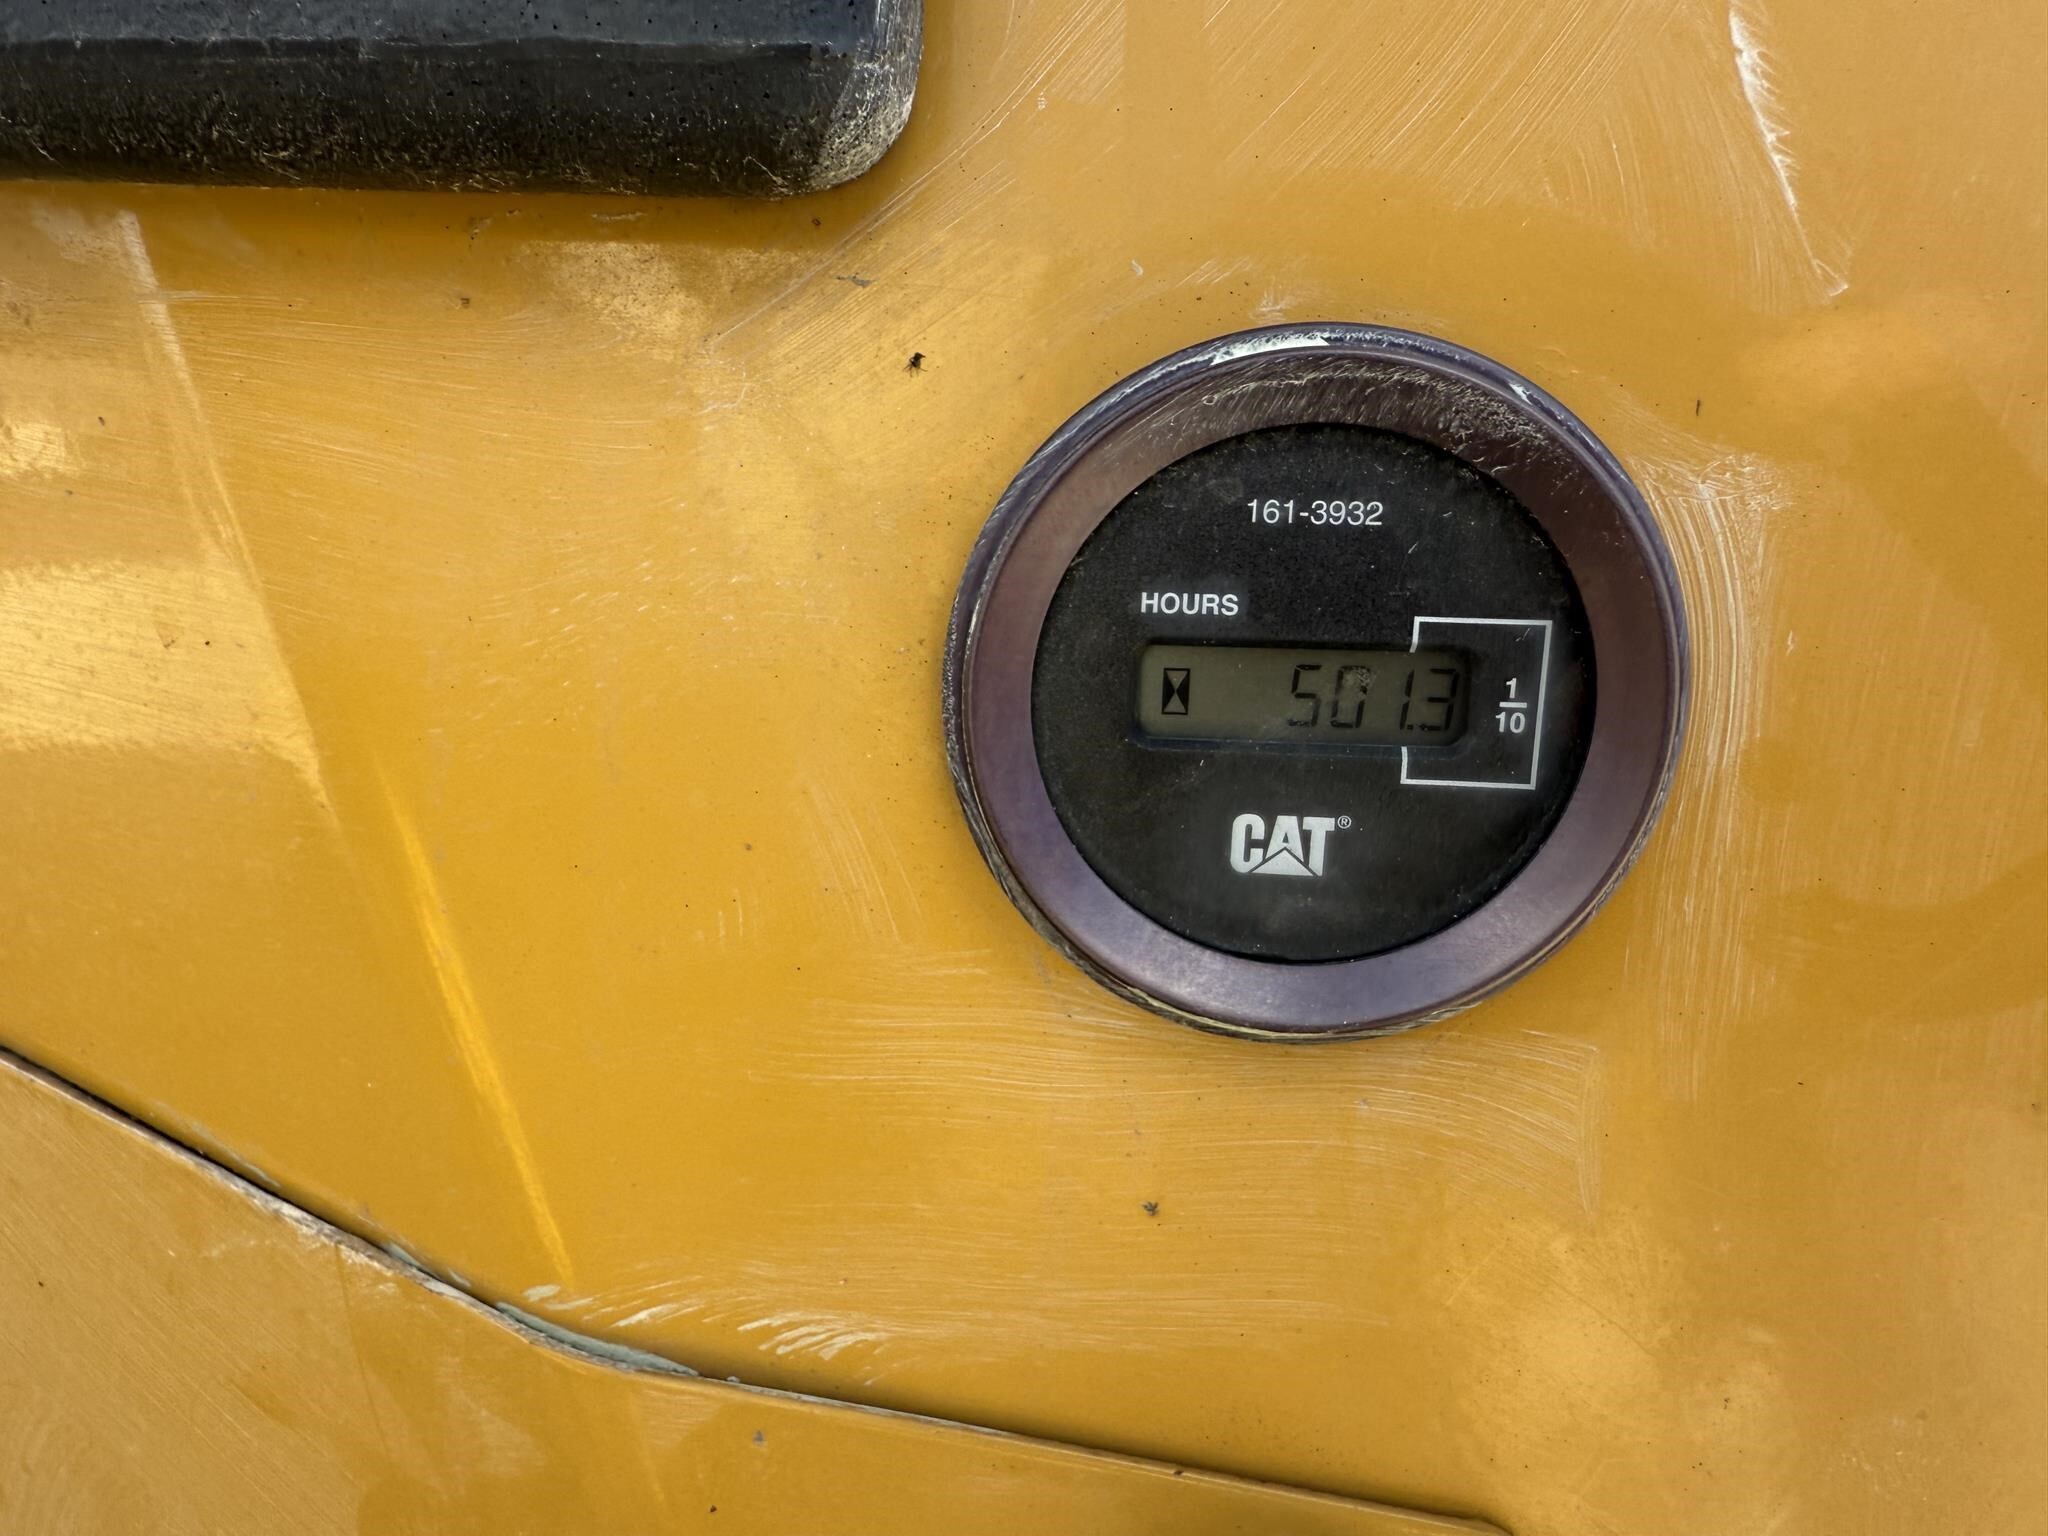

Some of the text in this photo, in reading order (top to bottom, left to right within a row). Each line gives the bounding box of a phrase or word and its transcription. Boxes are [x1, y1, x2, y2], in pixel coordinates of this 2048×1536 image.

[1247, 499, 1384, 526] 161-3932
[1140, 592, 1239, 616] HOURS
[1287, 664, 1460, 731] 501.3
